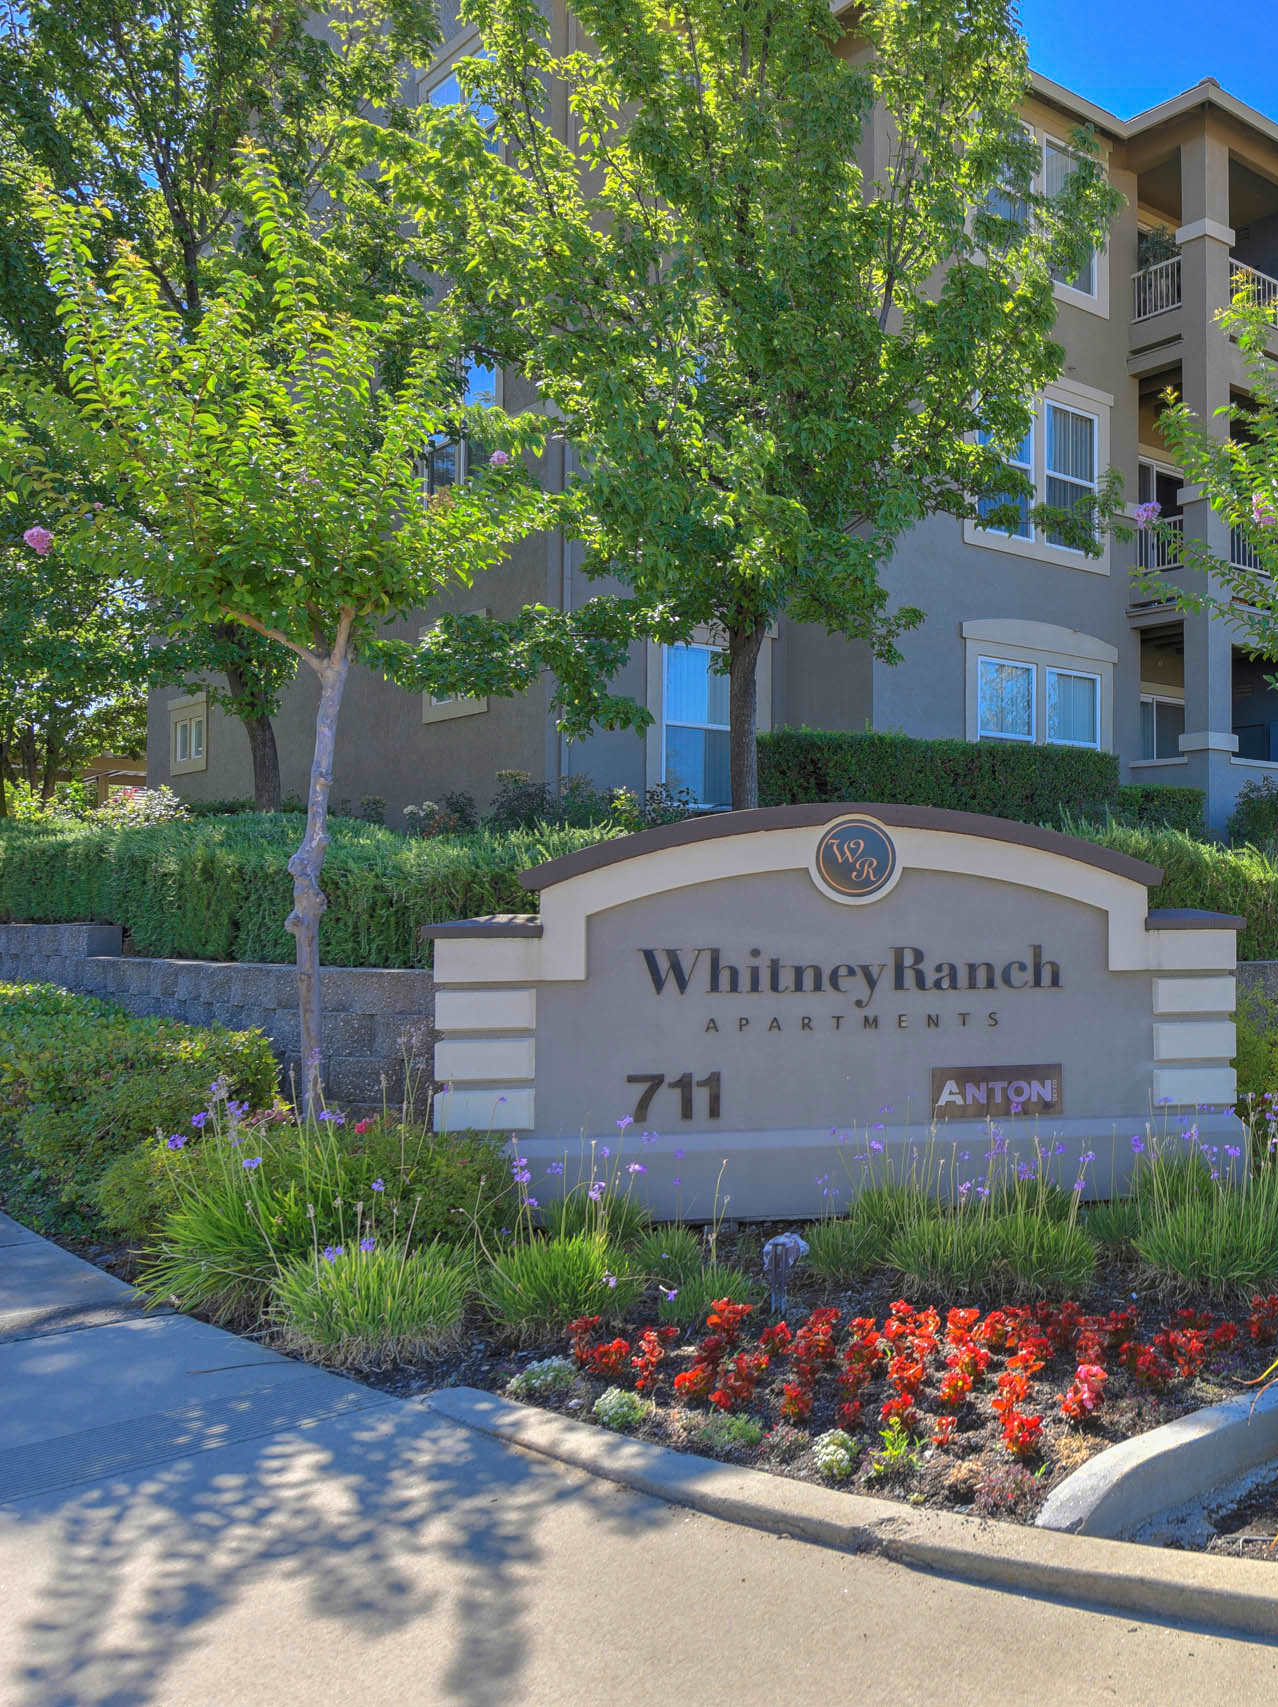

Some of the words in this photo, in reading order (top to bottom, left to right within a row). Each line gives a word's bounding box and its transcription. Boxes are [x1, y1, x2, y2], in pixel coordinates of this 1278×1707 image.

[704, 1011, 1000, 1033] APARTMENTS
[626, 1071, 722, 1123] 711
[936, 1079, 1052, 1105] ANTON
